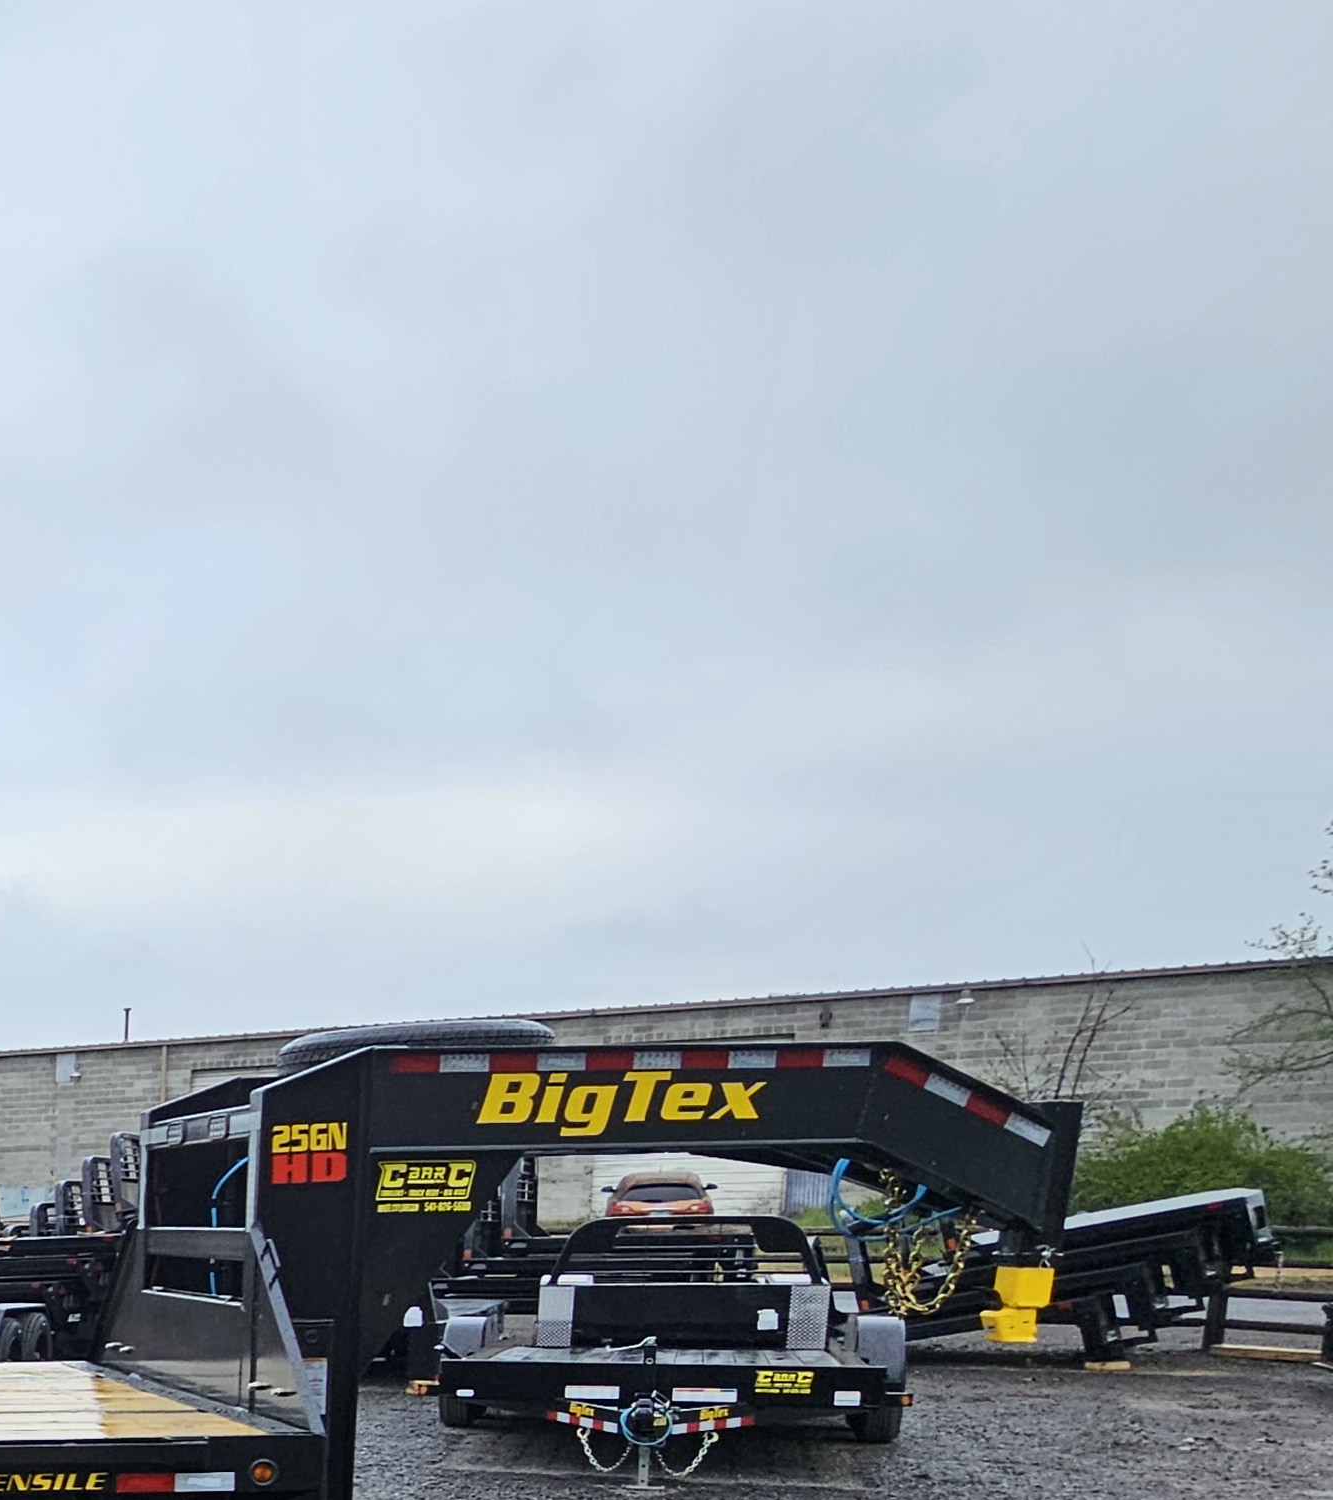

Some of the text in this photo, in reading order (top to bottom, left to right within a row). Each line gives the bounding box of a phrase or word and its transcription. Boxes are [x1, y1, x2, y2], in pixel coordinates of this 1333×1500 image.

[476, 1070, 767, 1137] BigTex
[272, 1122, 348, 1153] 25GN
[272, 1152, 347, 1184] HD
[382, 1163, 407, 1188] C
[447, 1163, 473, 1187] C
